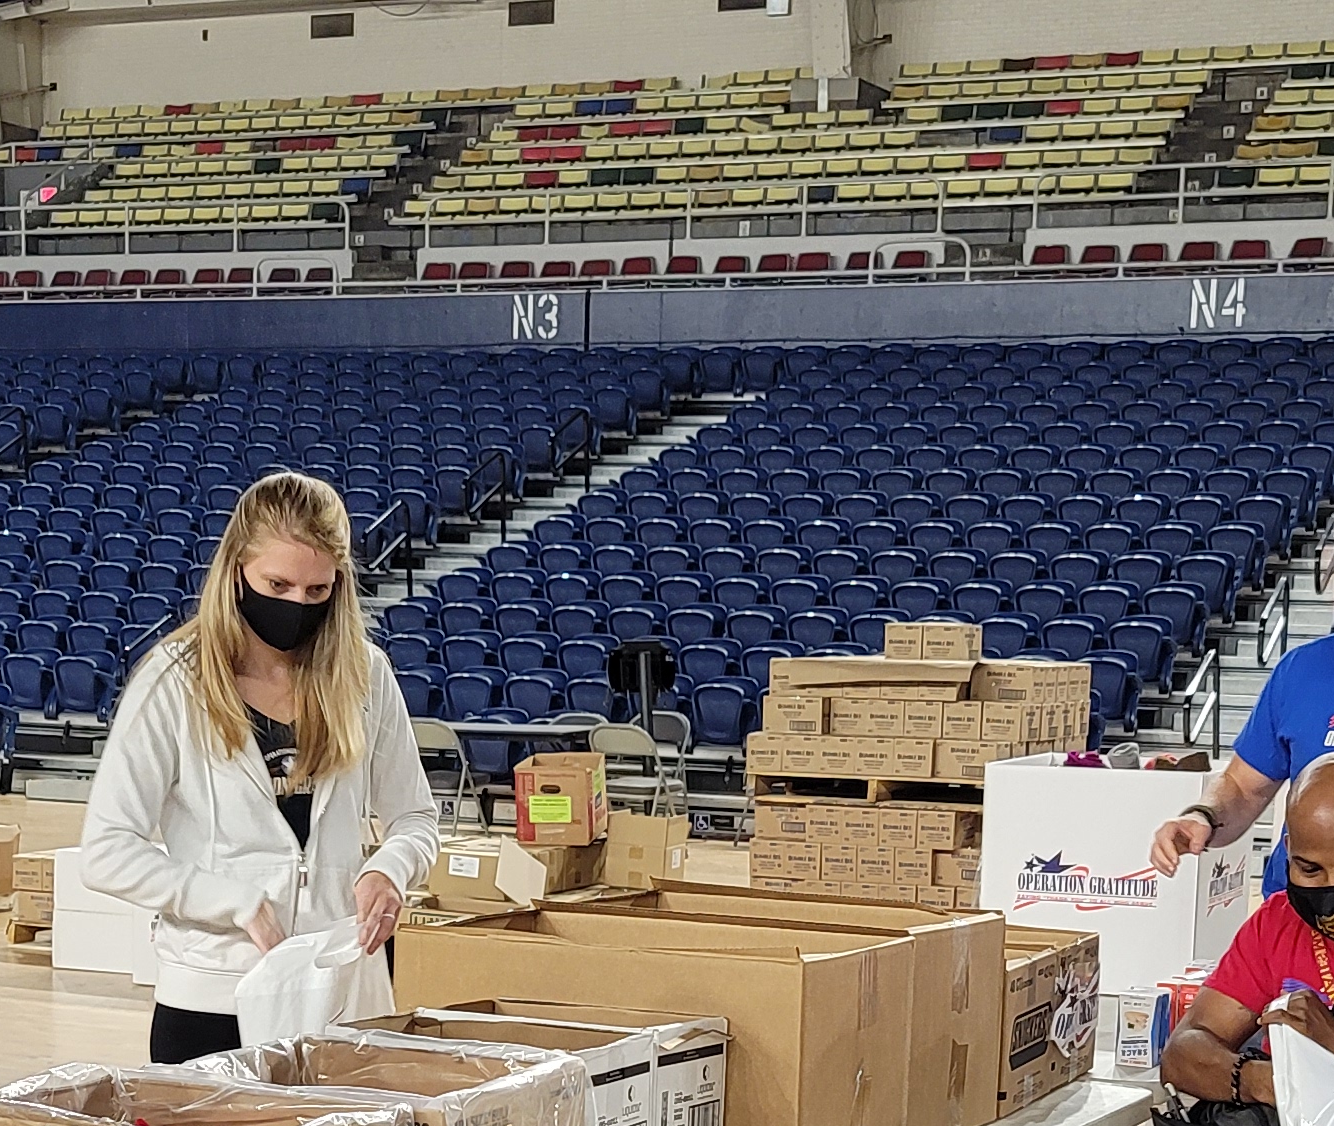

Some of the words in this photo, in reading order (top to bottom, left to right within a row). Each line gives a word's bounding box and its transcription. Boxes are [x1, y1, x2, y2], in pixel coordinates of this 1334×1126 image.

[512, 293, 559, 340] N3
[1190, 277, 1247, 329] N4
[1017, 872, 1085, 895] OPERATION
[1088, 876, 1158, 899] GRATITUDE
